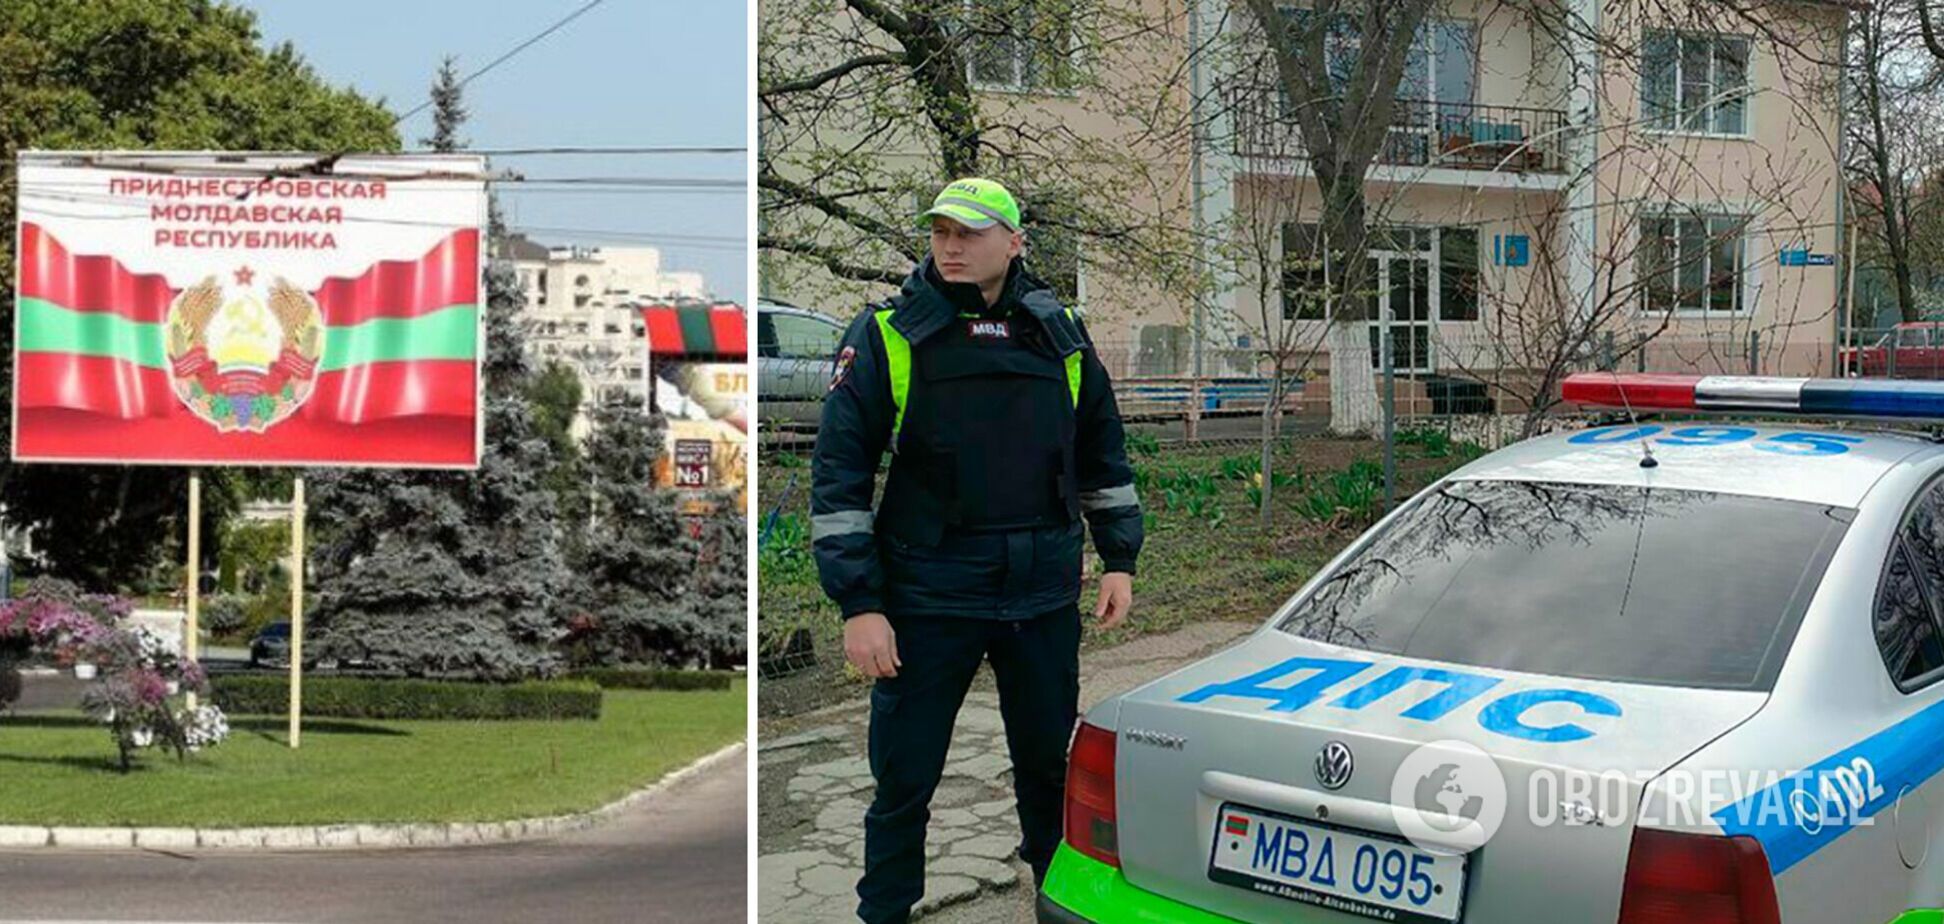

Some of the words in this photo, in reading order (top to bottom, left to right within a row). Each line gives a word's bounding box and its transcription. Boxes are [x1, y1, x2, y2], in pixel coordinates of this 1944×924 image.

[109, 177, 387, 200] ПРИДНЕСТРОВСКАЯ
[150, 205, 343, 226] МОЛДАВСКАЯ
[154, 229, 338, 250] РЕСПУБЛИКА
[971, 322, 1009, 337] МВД
[1567, 423, 1865, 456] 095
[678, 465, 708, 484] №1
[1177, 656, 1624, 743] ДПС
[1819, 756, 1885, 818] 102
[1352, 843, 1436, 907] 095
